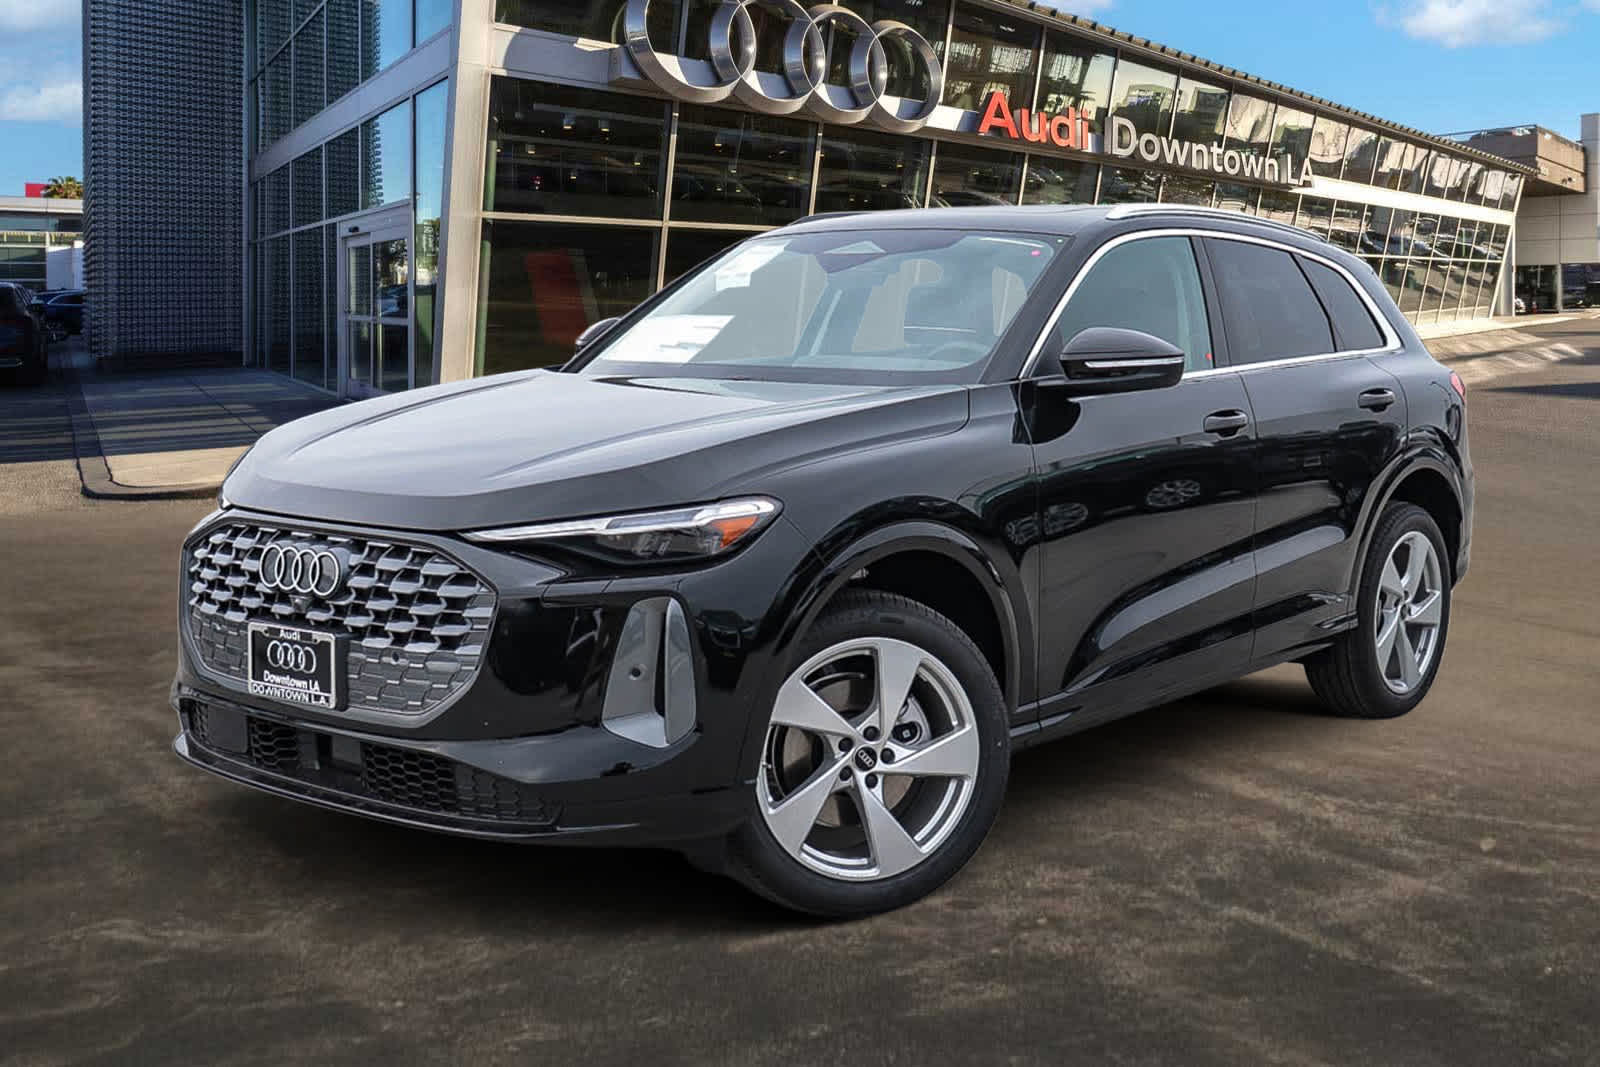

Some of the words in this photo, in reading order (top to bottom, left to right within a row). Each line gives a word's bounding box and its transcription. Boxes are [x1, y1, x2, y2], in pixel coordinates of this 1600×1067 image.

[978, 91, 1089, 150] Audi
[1105, 115, 1279, 184] Downtown
[1283, 152, 1316, 188] LA
[280, 629, 300, 640] Audi
[263, 670, 308, 689] Downtown
[309, 680, 320, 692] LA
